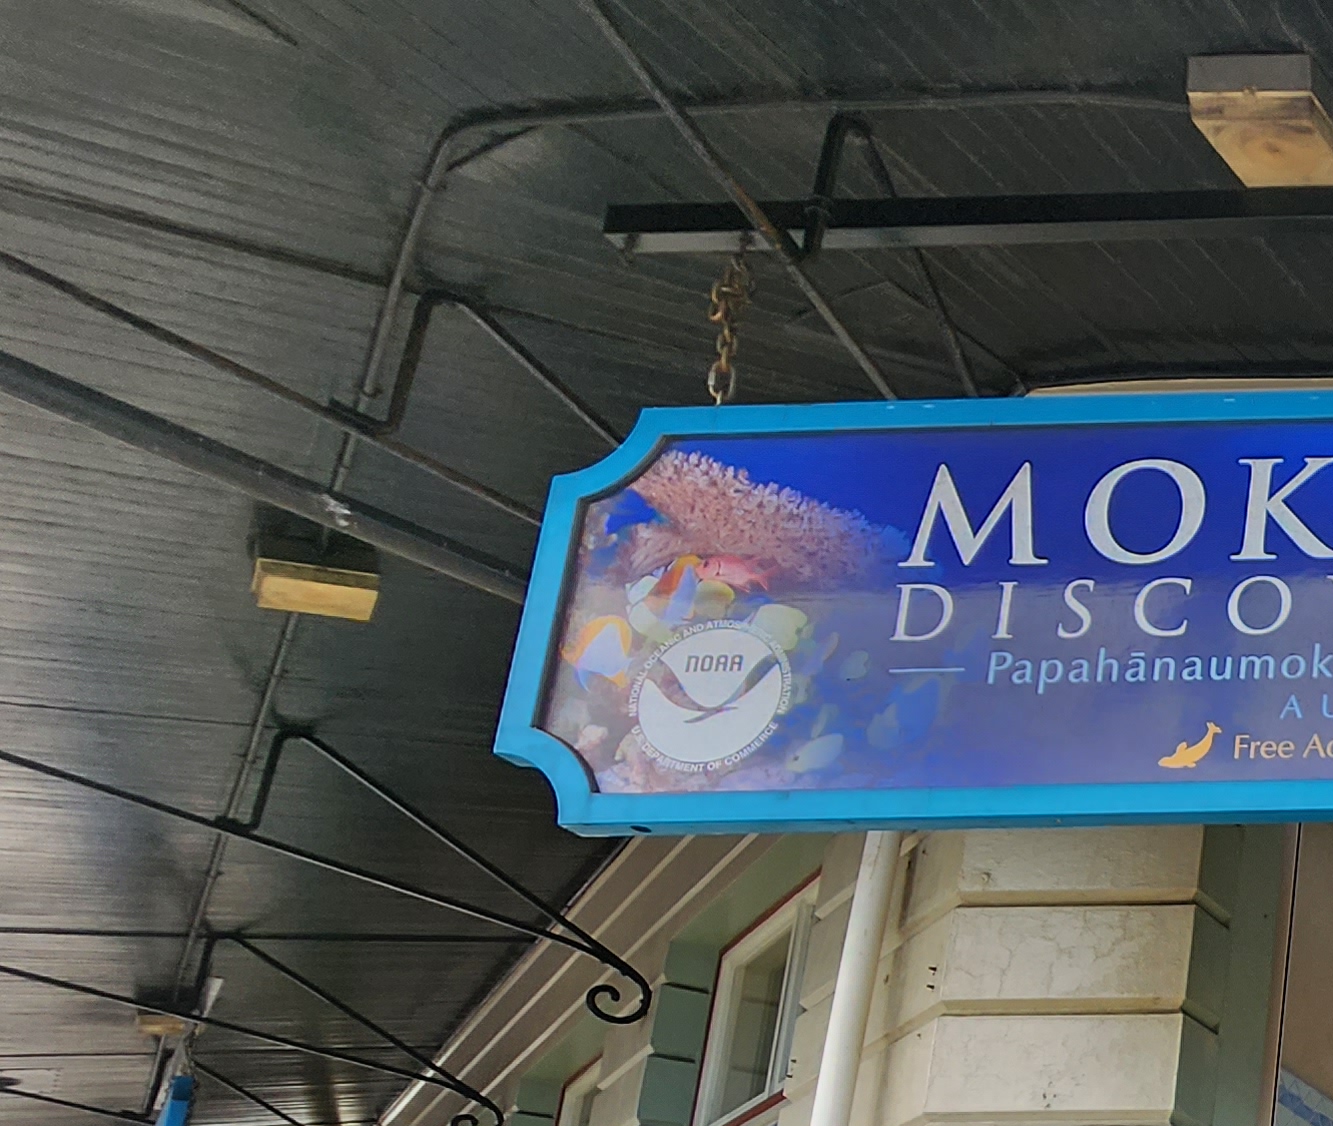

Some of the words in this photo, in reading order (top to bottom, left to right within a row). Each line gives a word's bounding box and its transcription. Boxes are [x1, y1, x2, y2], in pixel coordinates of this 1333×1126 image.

[629, 670, 648, 717] NATIONAL
[645, 633, 682, 670] OCEANIC
[682, 623, 705, 639] AND
[685, 654, 744, 673] NOAA
[1280, 694, 1303, 719] A
[641, 742, 705, 772] DEPARTMENT
[706, 761, 722, 771] OF
[724, 721, 778, 766] COMMERCE
[1233, 734, 1297, 760] Free
